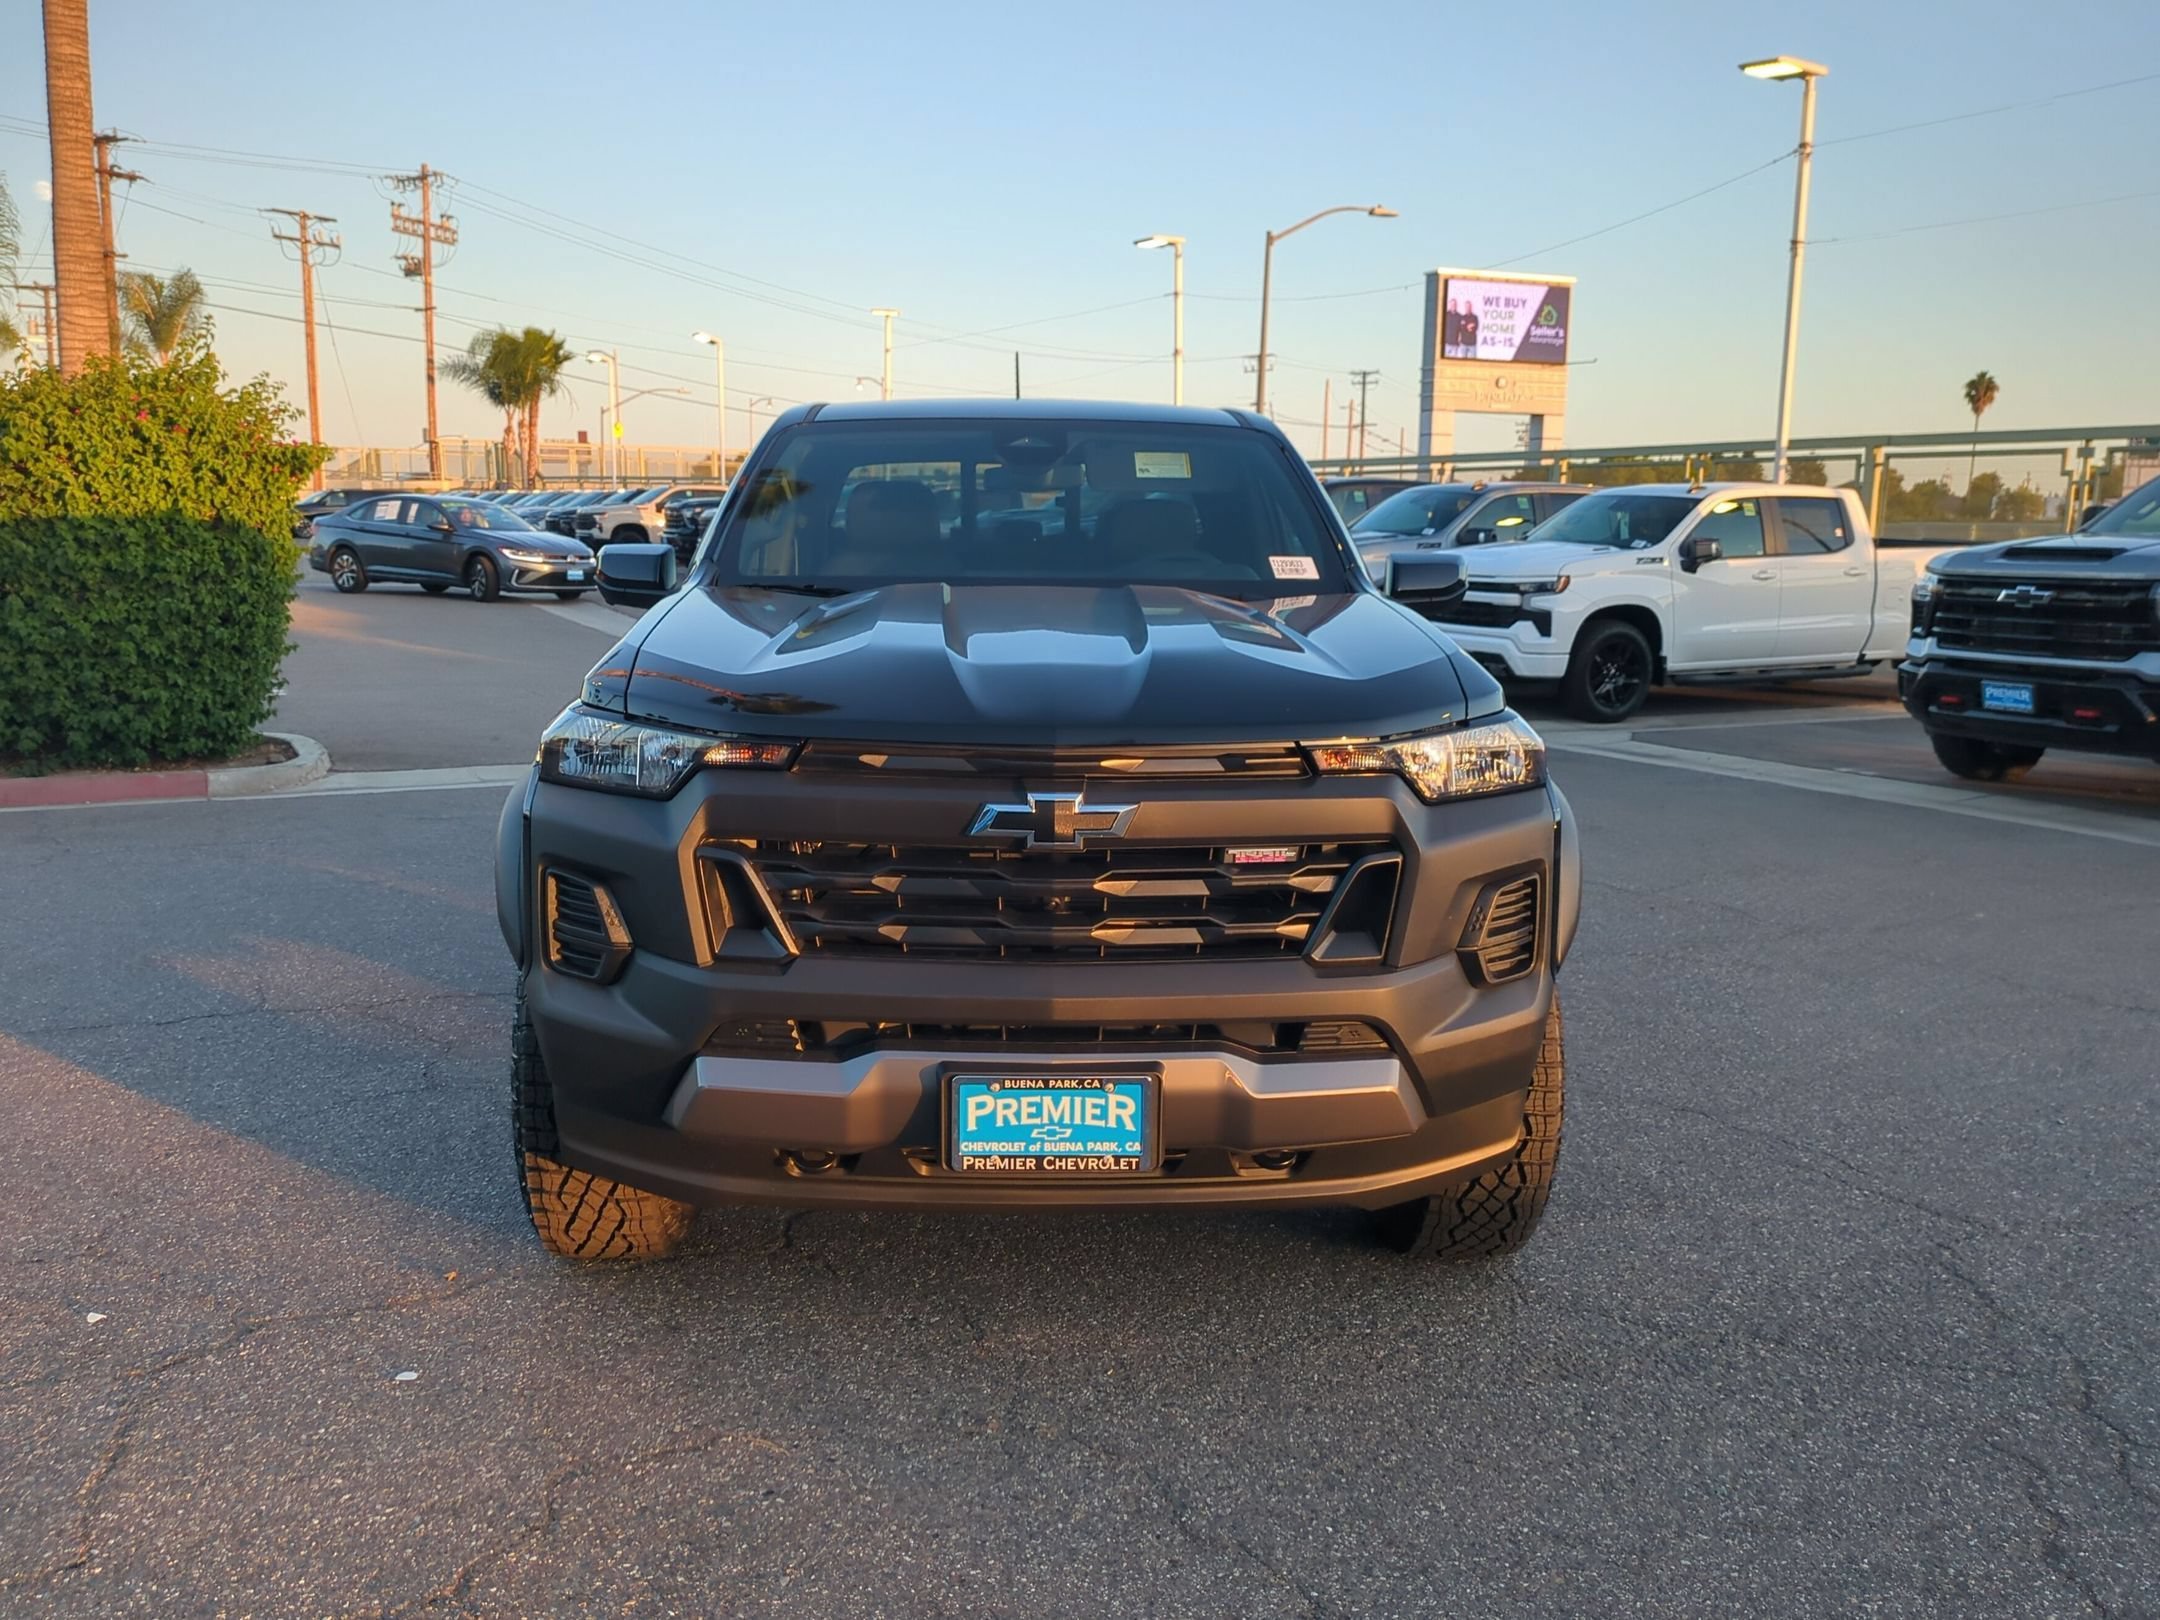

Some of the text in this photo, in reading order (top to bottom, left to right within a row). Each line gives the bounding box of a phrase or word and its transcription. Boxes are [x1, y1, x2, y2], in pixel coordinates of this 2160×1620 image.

[1482, 296, 1527, 309] WE BUY
[1483, 309, 1515, 321] YOUR
[1481, 322, 1516, 335] HOME
[1004, 1079, 1045, 1089] BUENA
[966, 1094, 1137, 1132] PREMIER
[961, 1142, 1141, 1153] CHEVROLET of BUENA PARK, CA
[963, 1156, 1139, 1170] PREMIER CHEVROLET
